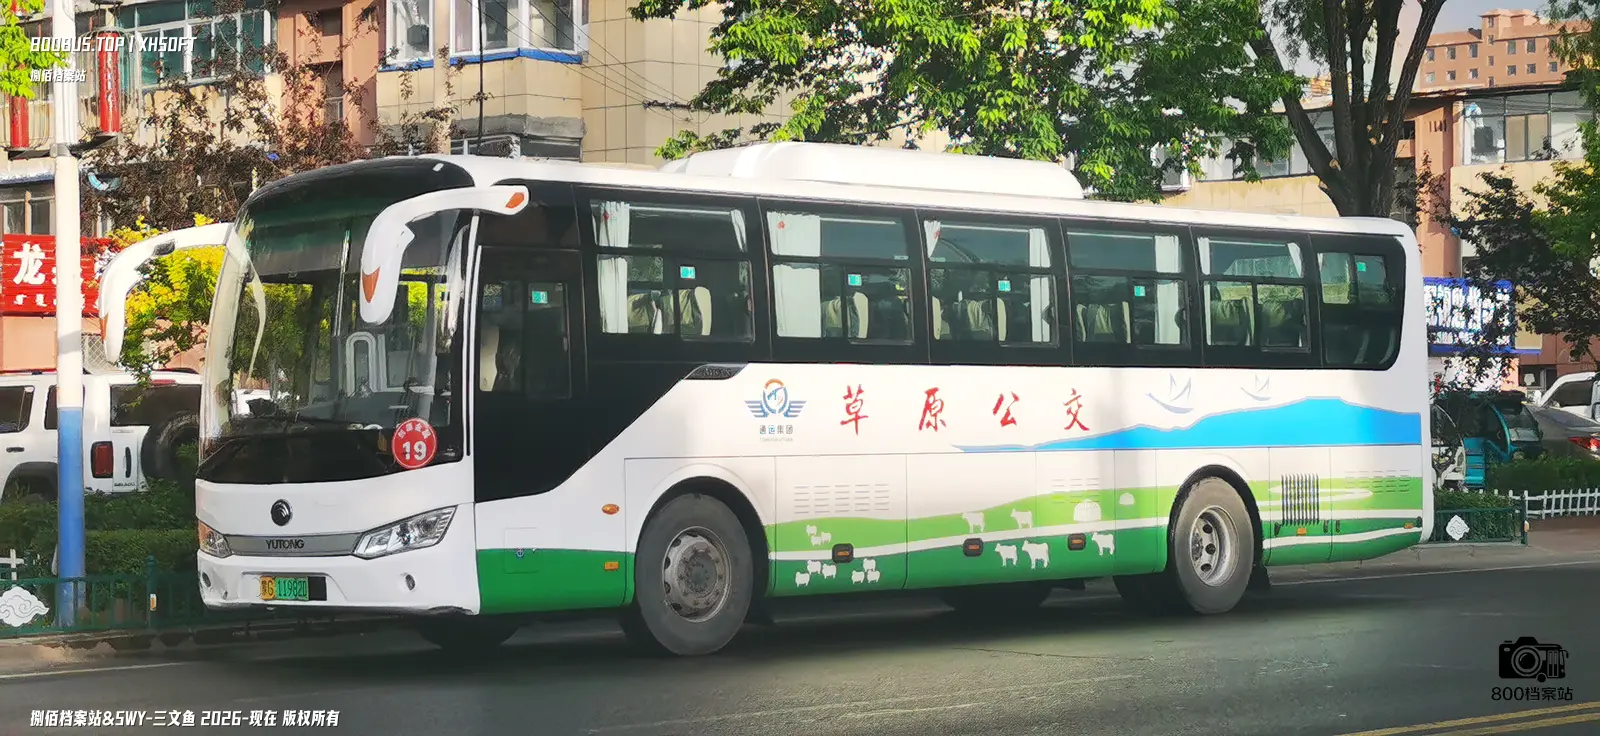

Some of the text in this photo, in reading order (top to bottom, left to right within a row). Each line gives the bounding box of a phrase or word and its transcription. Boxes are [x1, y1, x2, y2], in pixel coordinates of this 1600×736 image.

[840, 384, 1090, 435] 草原公交
[759, 424, 793, 435] 通运集团
[402, 440, 427, 461] 19
[265, 538, 305, 550] YUTONG
